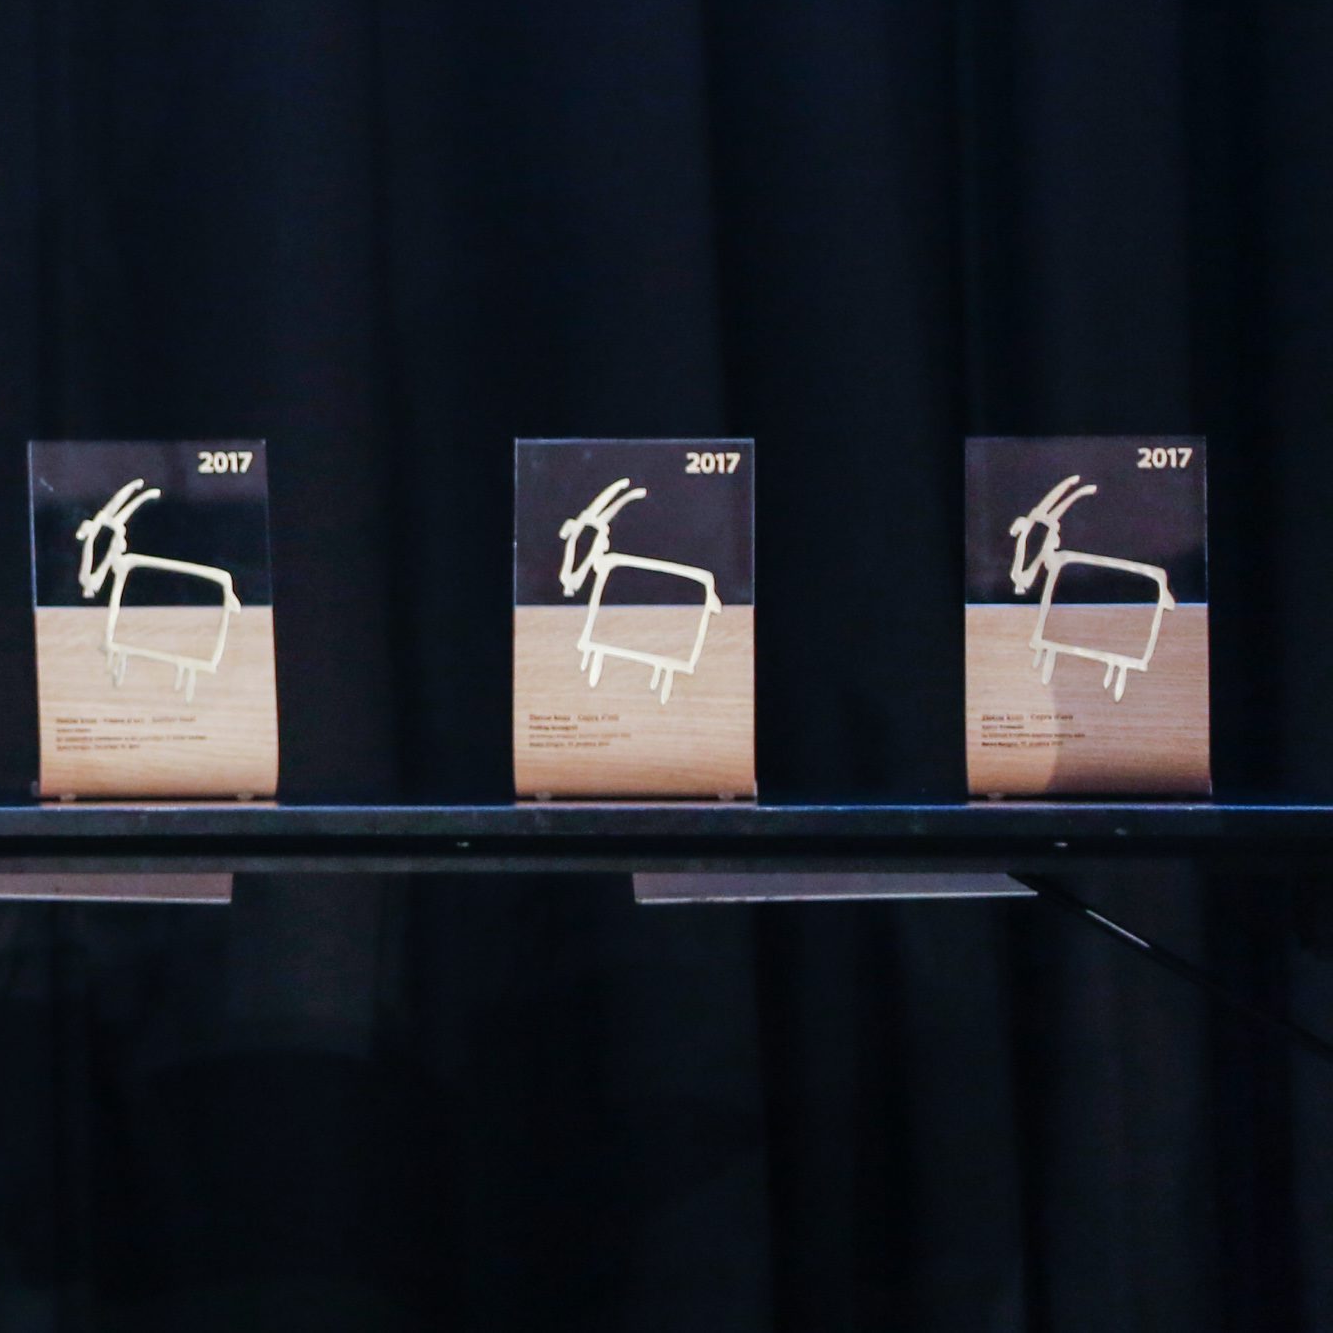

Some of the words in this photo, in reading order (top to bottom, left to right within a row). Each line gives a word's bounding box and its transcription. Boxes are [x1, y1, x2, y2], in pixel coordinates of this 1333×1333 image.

[198, 451, 254, 474] 2017
[685, 452, 741, 474] 2017
[1137, 447, 1193, 469] 2017
